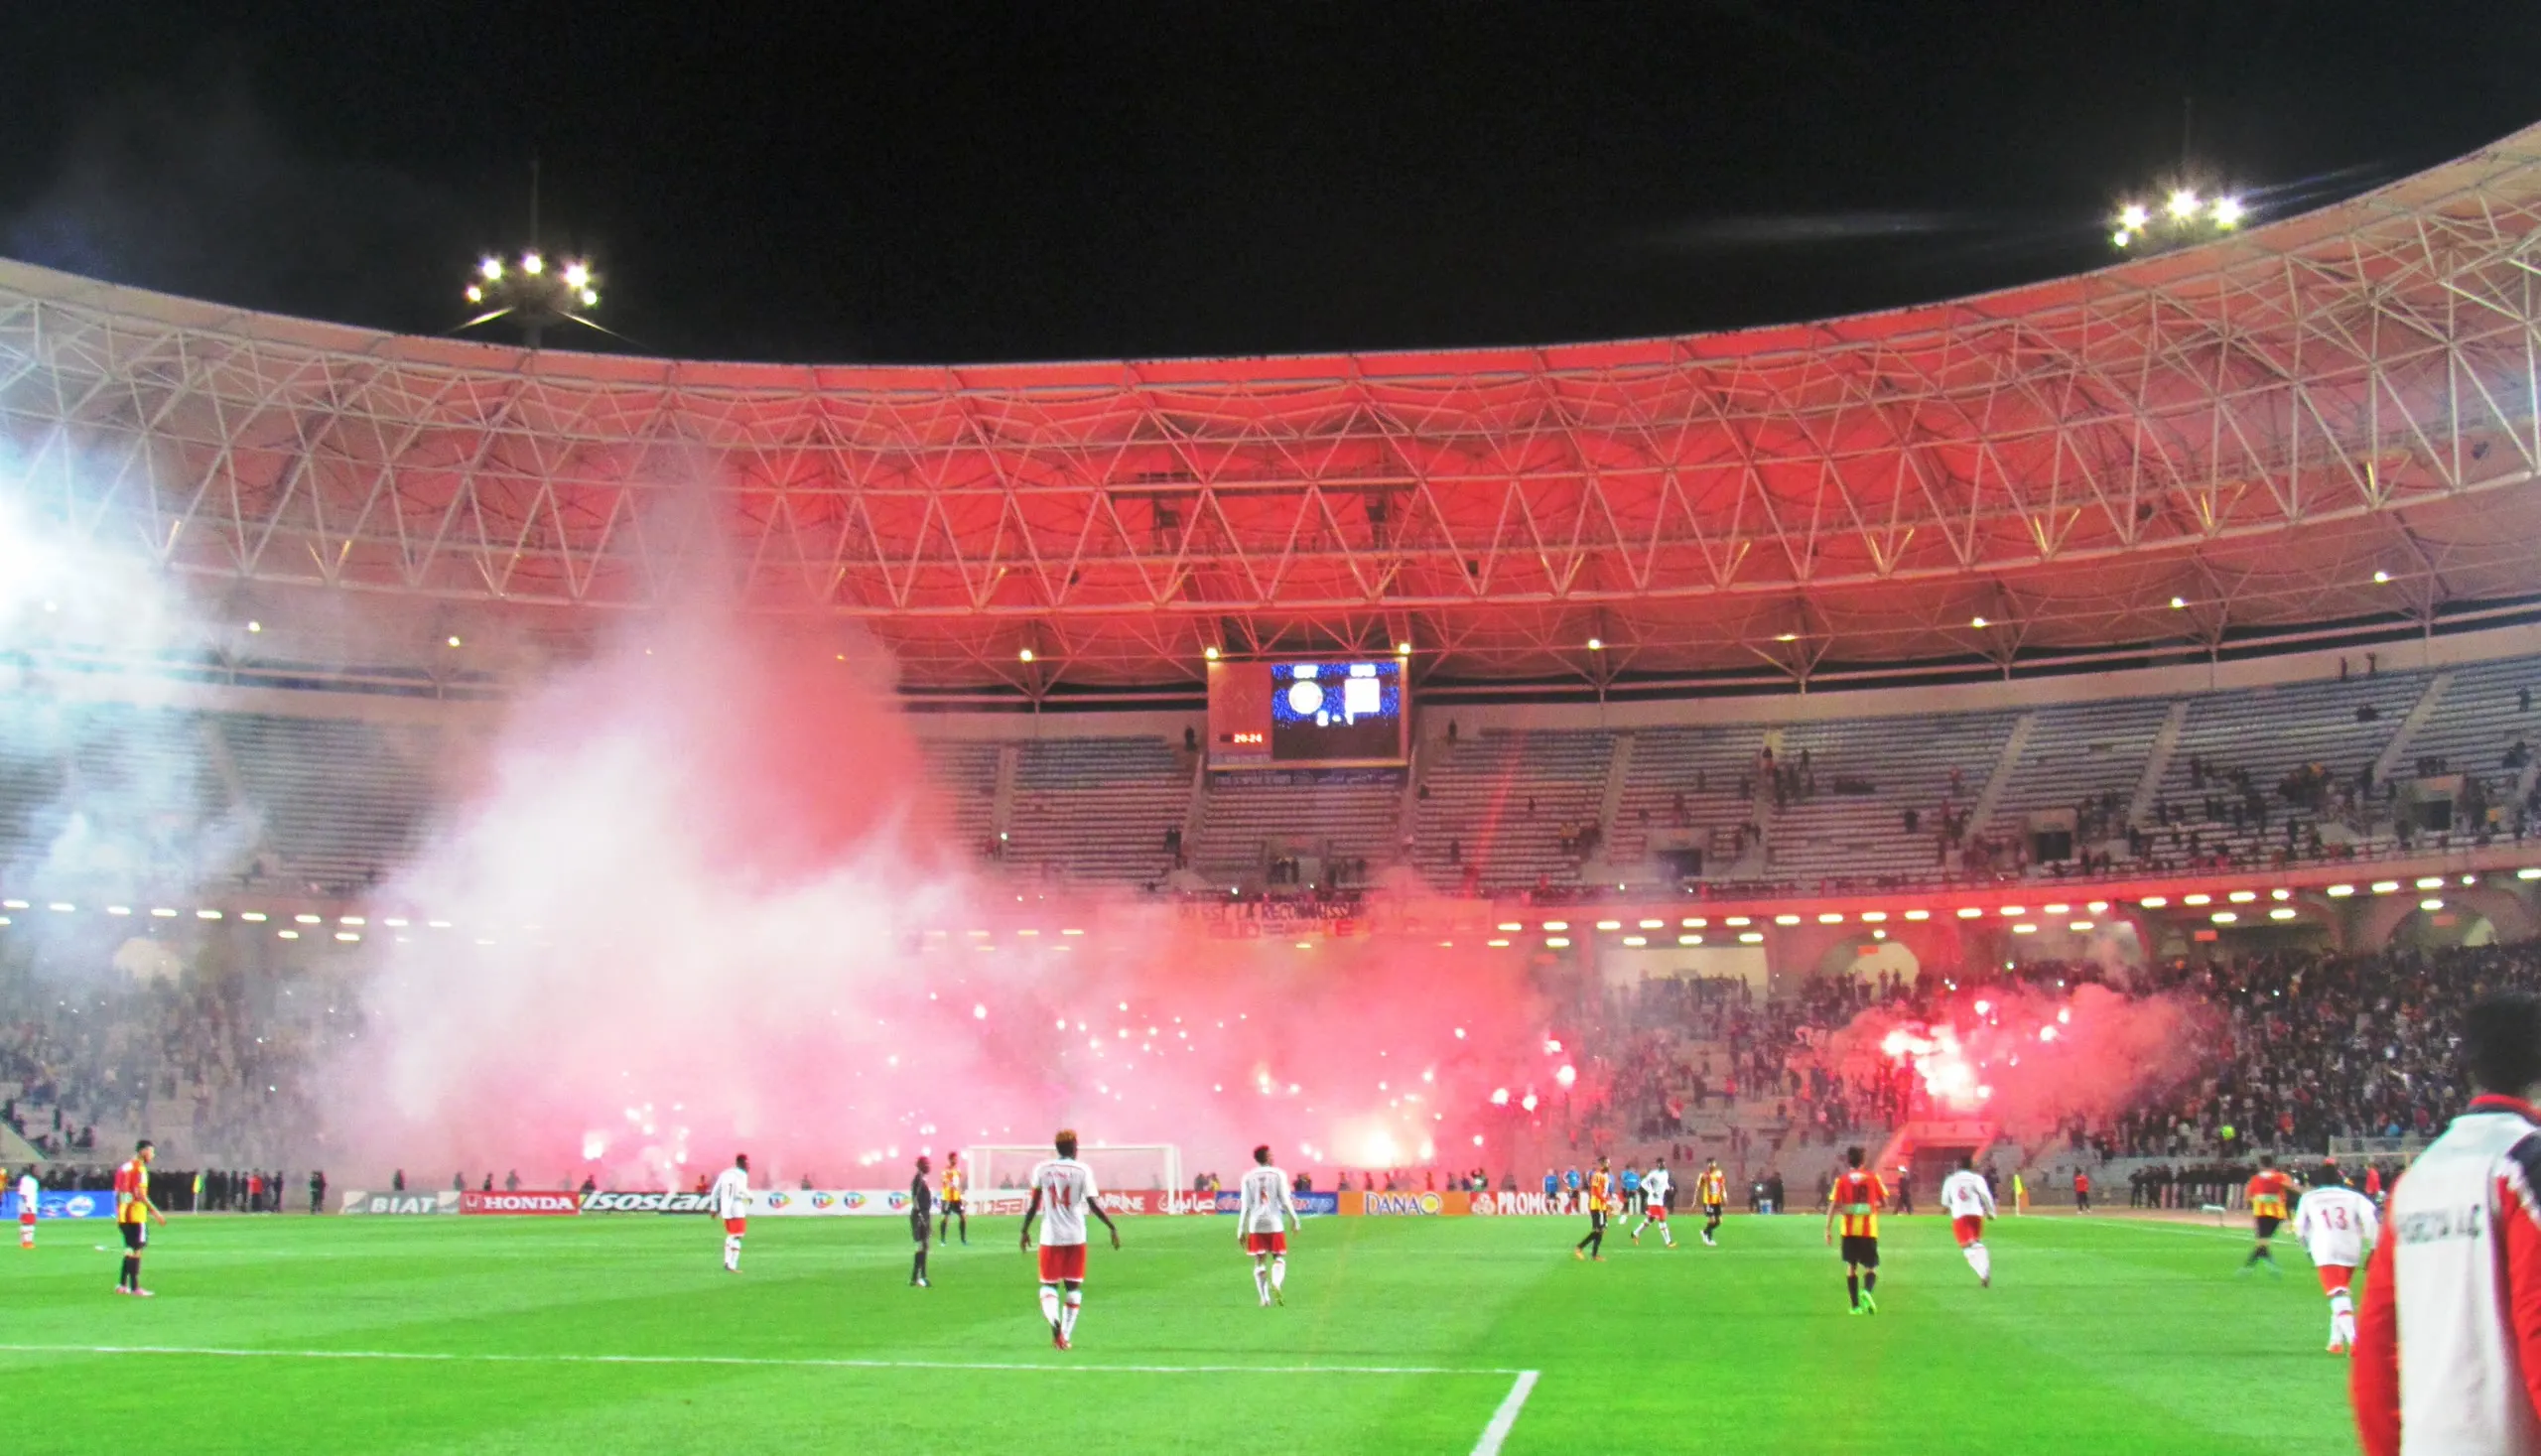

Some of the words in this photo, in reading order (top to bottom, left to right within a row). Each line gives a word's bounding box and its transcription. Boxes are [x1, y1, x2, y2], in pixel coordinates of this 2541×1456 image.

[369, 1197, 437, 1214] BIAT
[483, 1196, 575, 1211] HONDA
[1365, 1192, 1441, 1216] DANAO
[2320, 1206, 2349, 1231] 13
